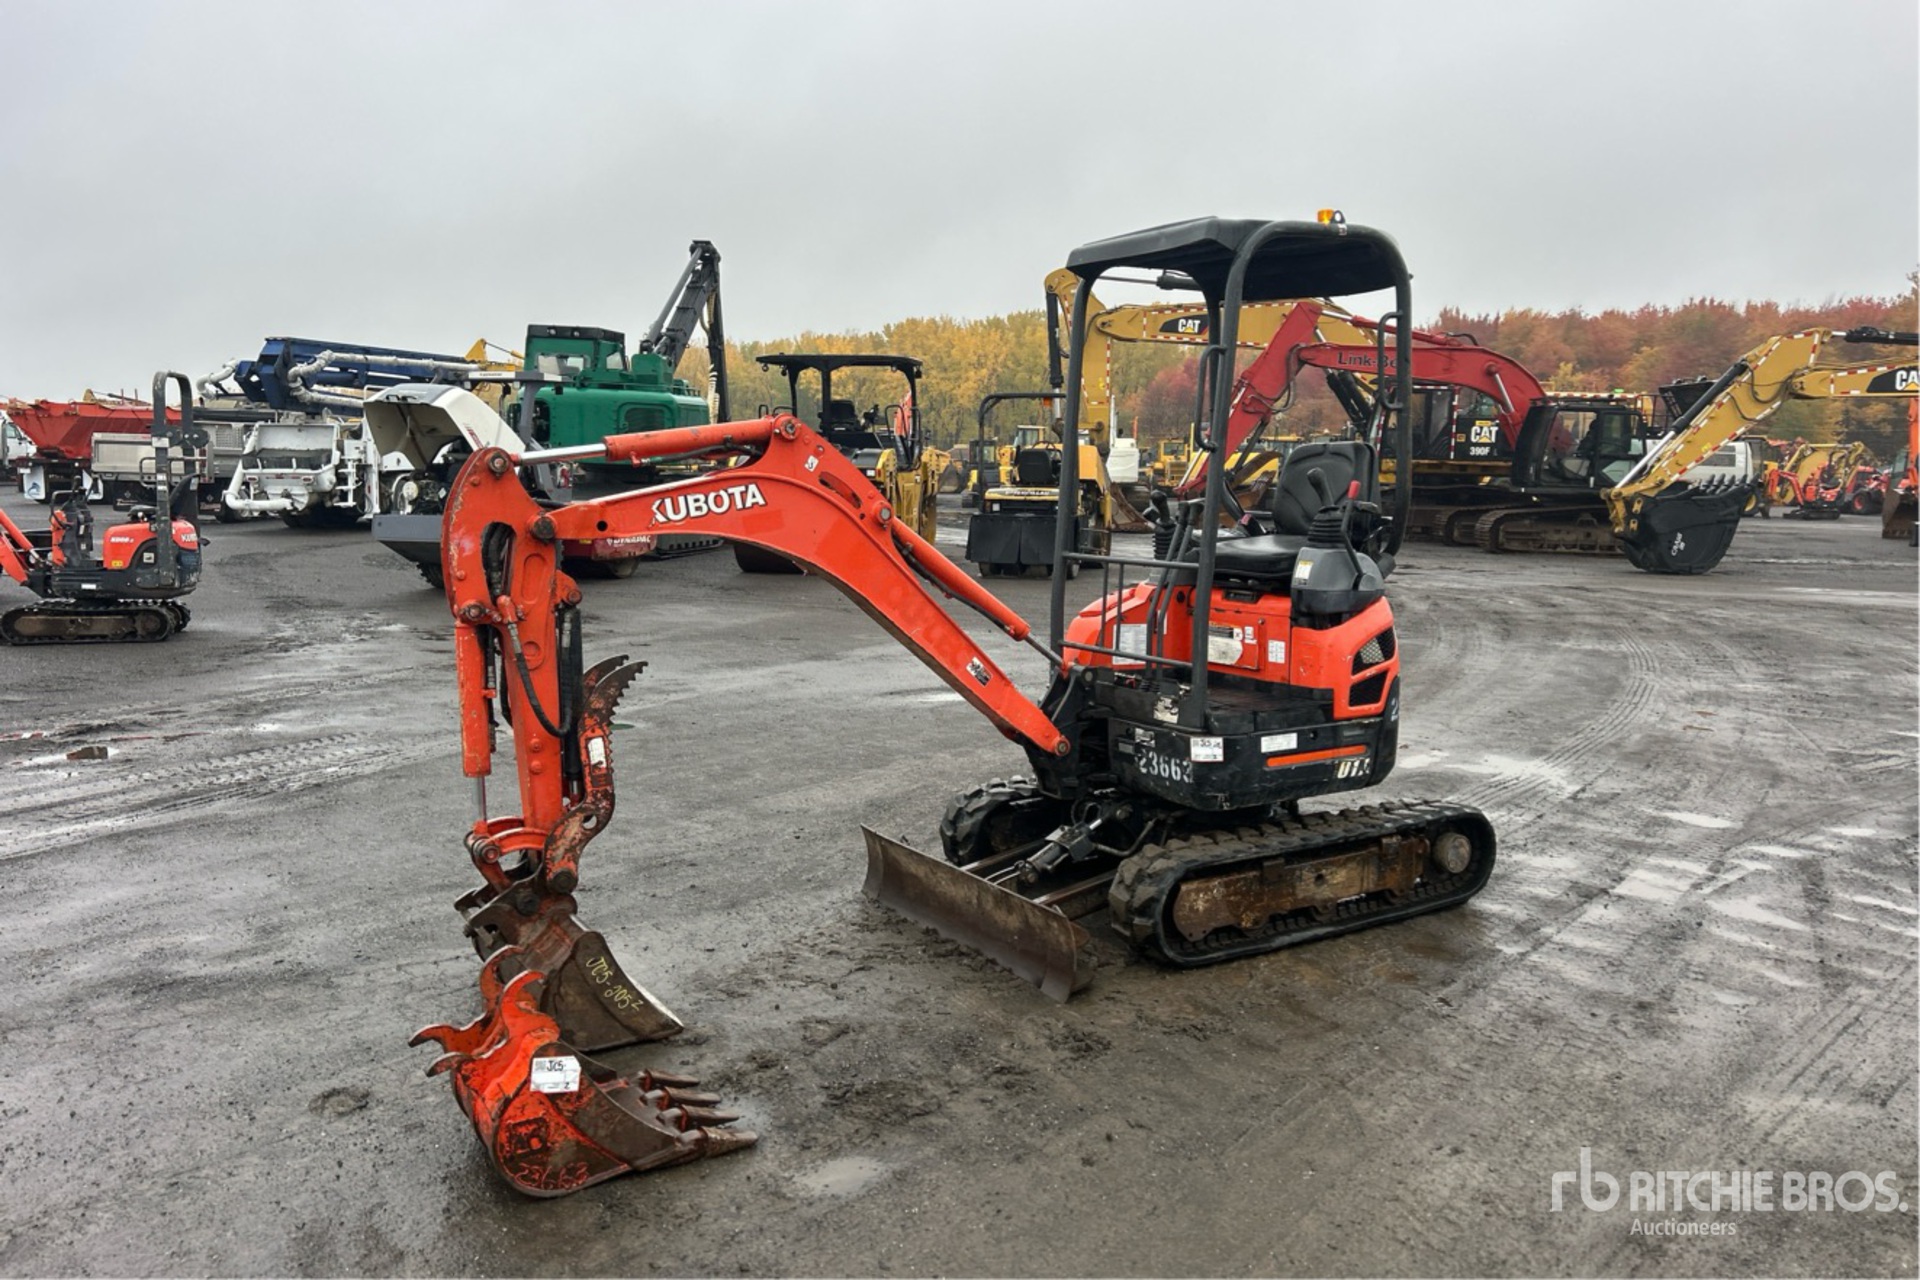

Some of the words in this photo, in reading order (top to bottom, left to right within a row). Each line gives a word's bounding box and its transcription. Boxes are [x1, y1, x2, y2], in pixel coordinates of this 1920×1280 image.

[1178, 318, 1201, 333] CAT
[1895, 370, 1919, 391] CA
[1471, 426, 1499, 443] CAT
[1470, 446, 1491, 456] 390F
[651, 483, 766, 524] KUBOTA
